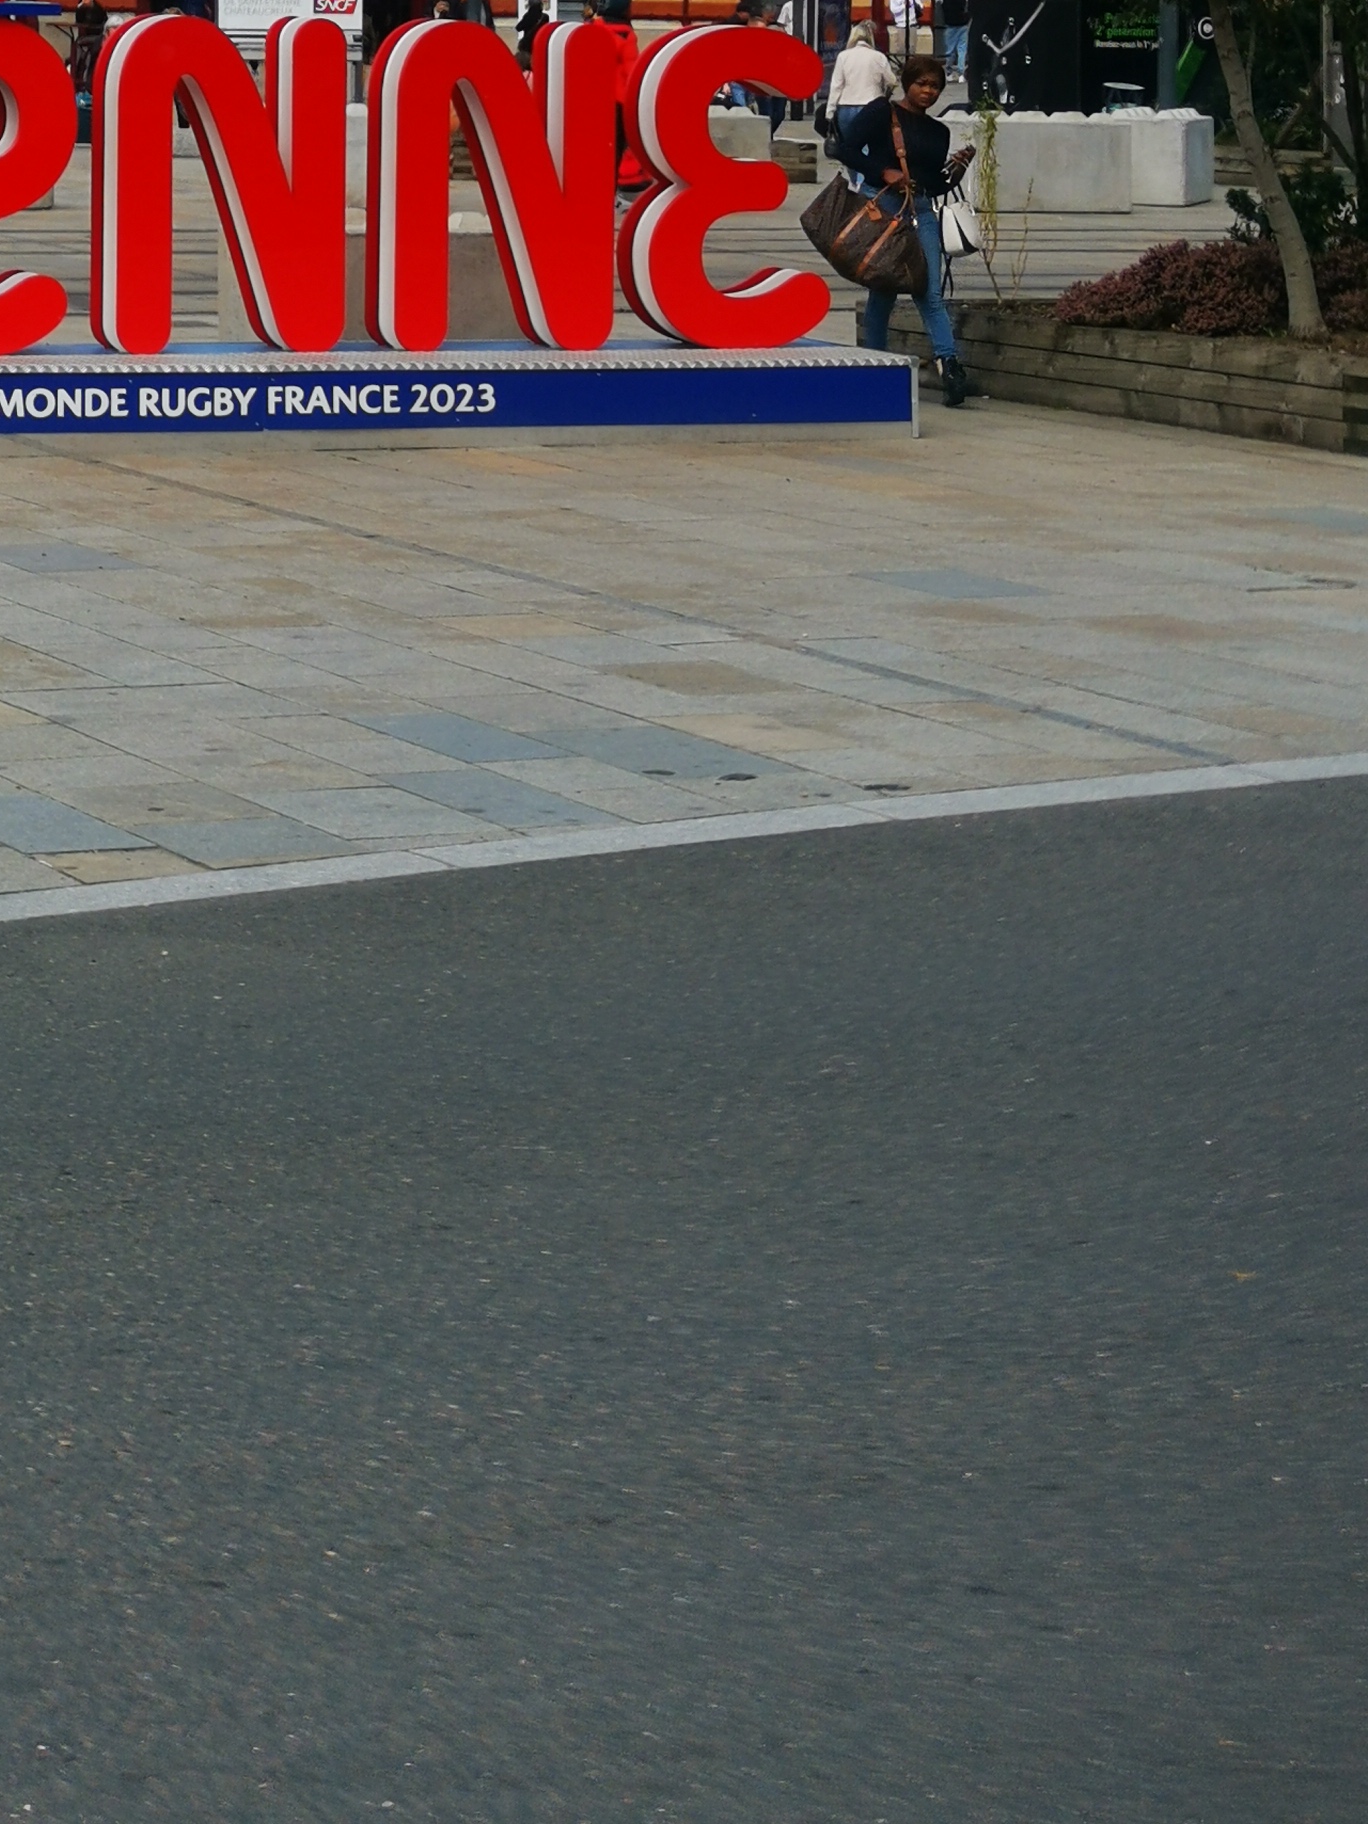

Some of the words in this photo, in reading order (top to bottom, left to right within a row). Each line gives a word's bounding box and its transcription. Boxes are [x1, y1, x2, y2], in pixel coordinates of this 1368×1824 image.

[139, 386, 257, 418] RUGBY
[267, 383, 402, 416] FRANCE
[408, 382, 497, 414] 2023
